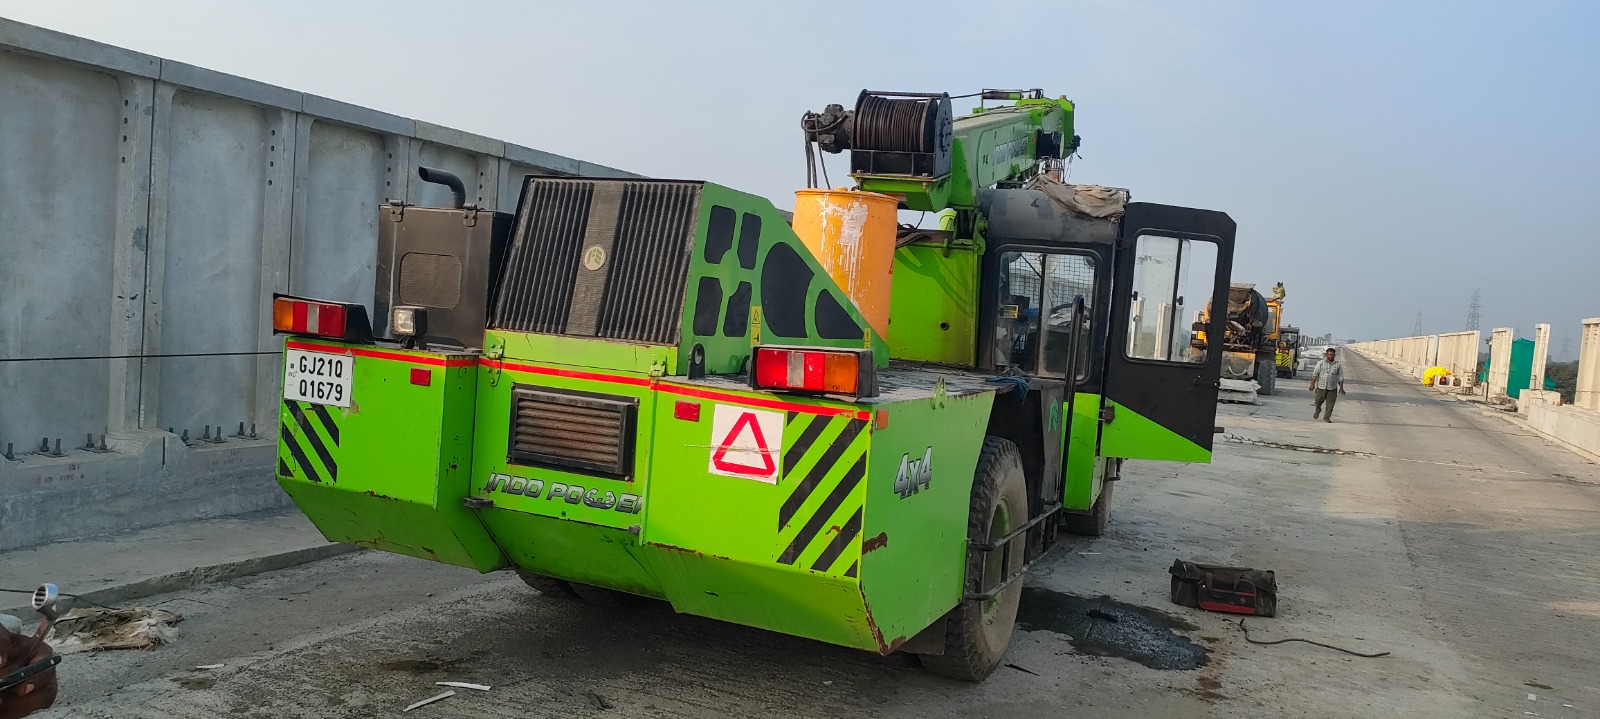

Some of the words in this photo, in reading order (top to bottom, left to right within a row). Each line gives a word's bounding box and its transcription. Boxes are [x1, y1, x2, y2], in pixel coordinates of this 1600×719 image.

[300, 356, 343, 378] GJ21Q
[300, 379, 343, 401] Q1679
[485, 472, 544, 498] INDO
